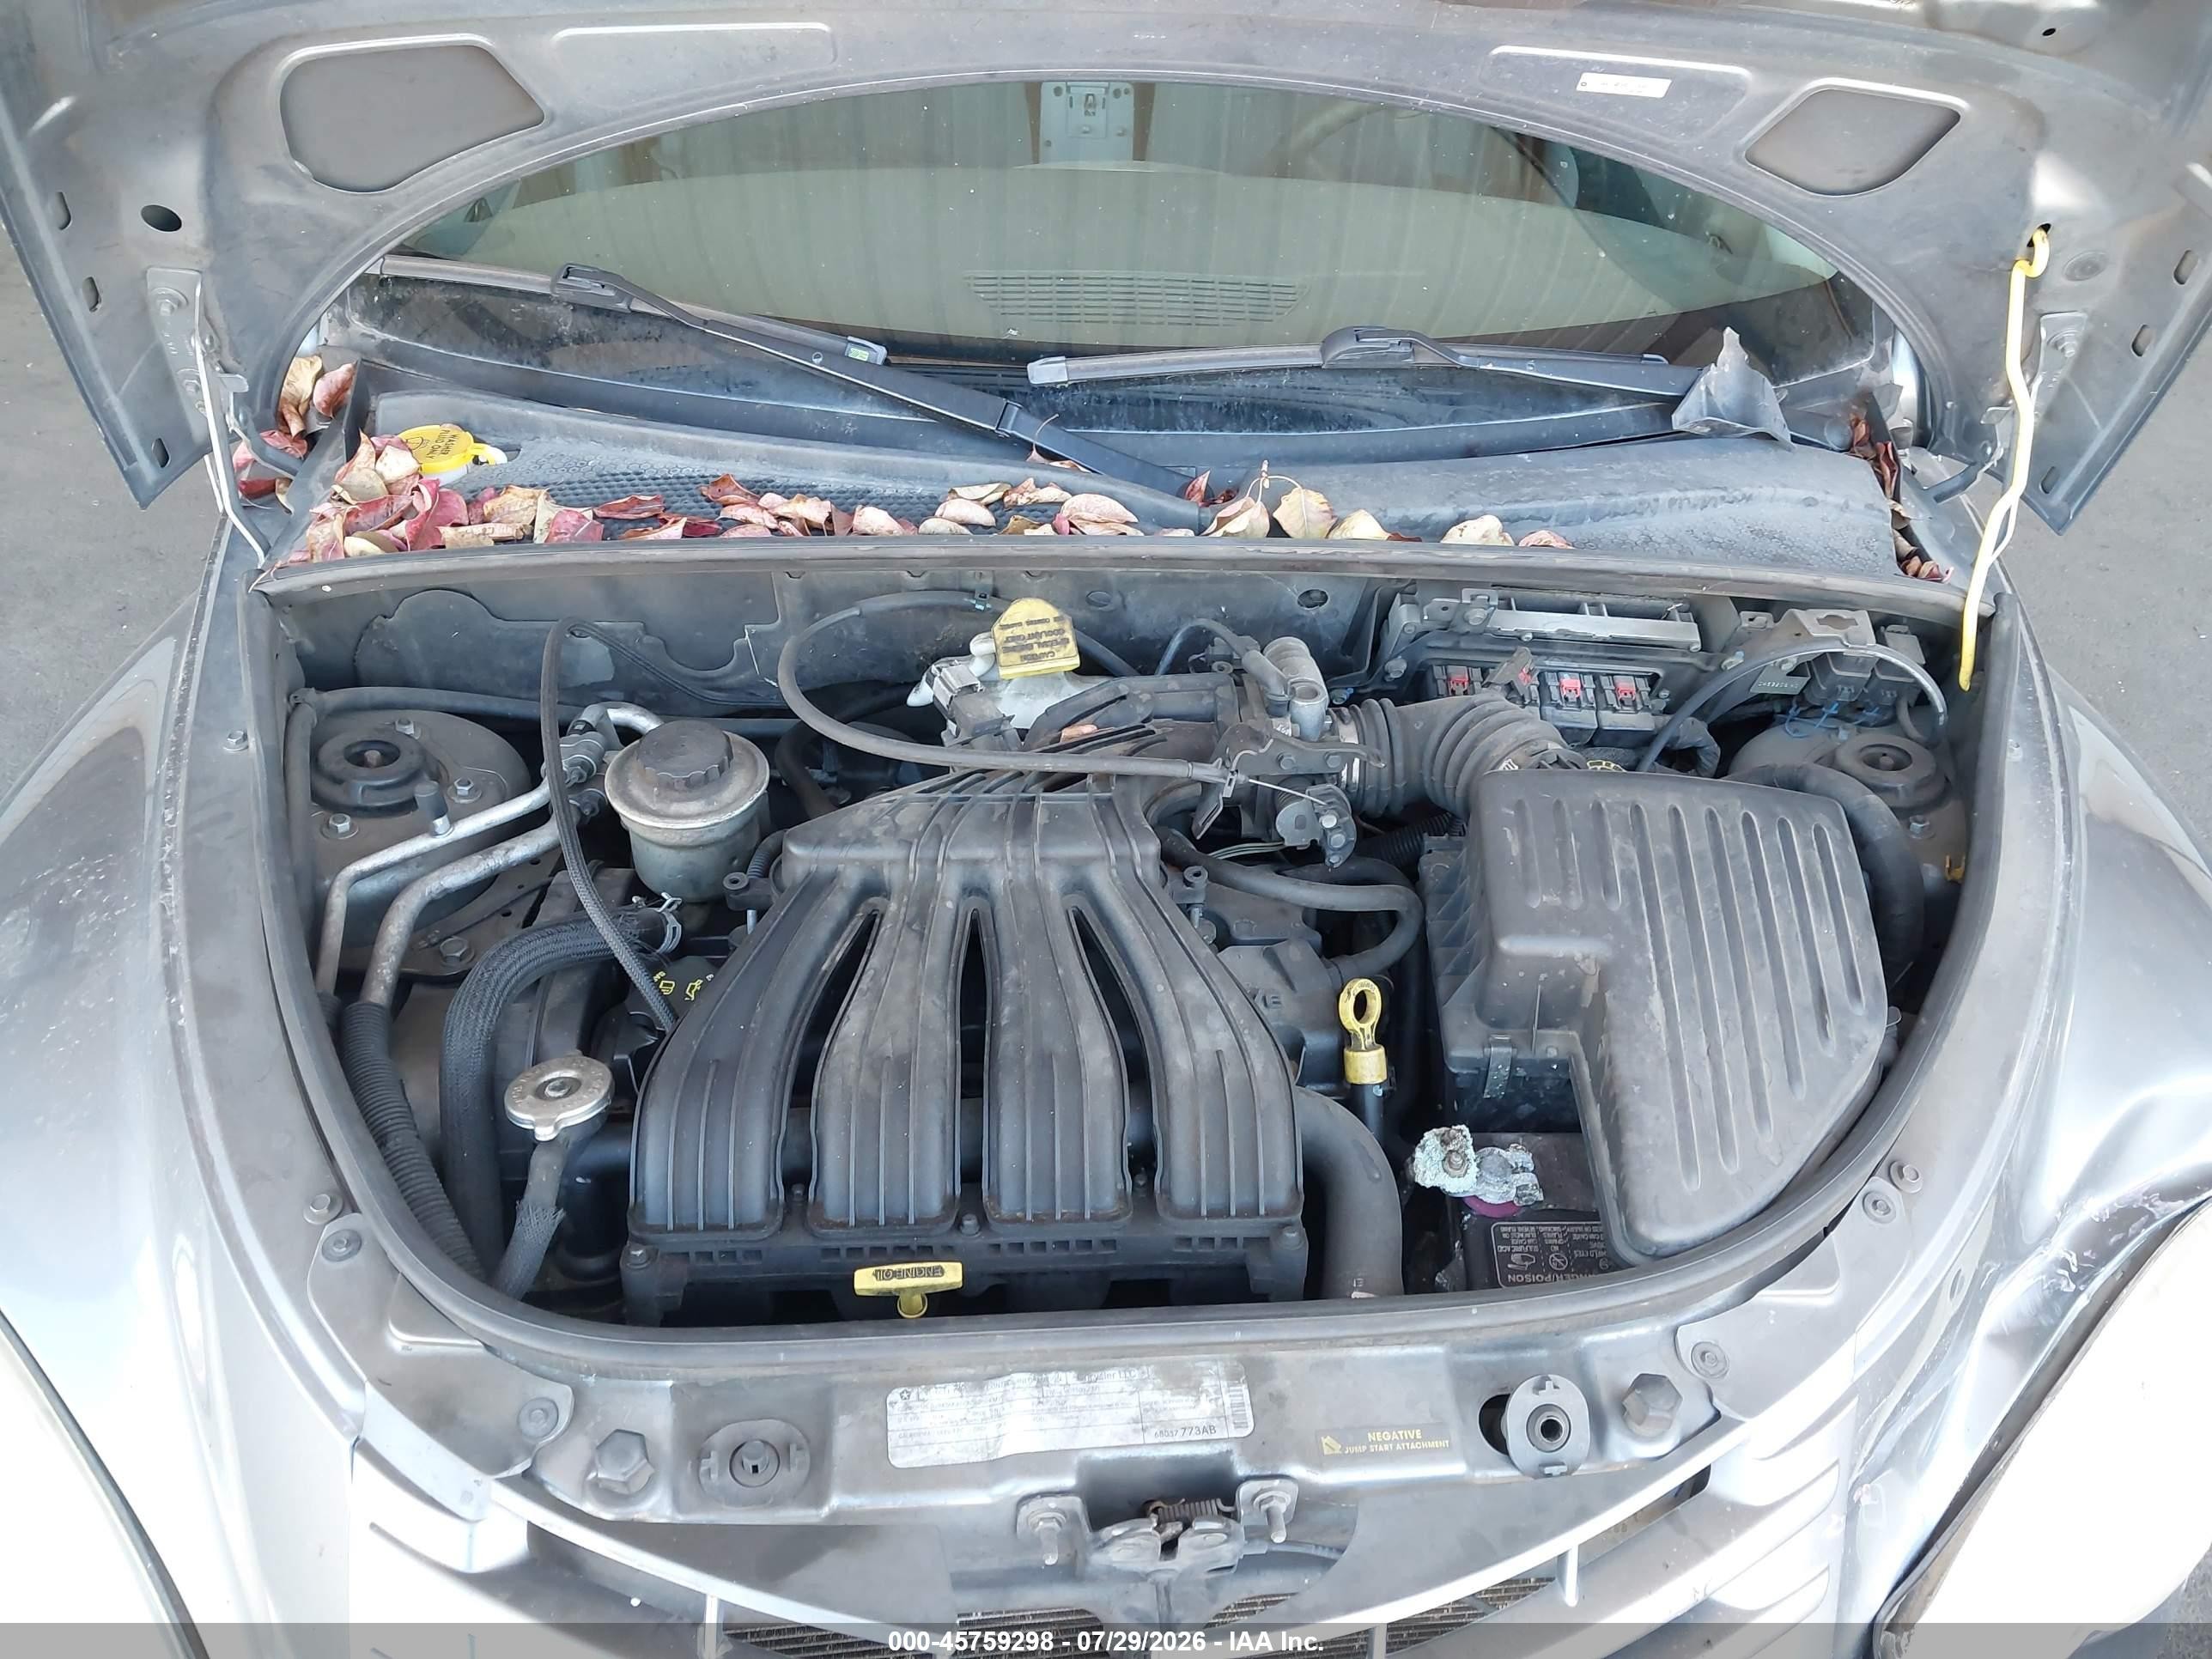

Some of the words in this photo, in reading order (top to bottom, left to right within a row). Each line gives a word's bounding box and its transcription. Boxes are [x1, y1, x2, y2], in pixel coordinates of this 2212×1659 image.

[439, 434, 460, 456] WASHER
[877, 1269, 893, 1280] OIL
[896, 1266, 942, 1279] ENGINE
[1367, 1429, 1422, 1442] NEGATIVE
[1344, 1444, 1367, 1454] JUMP
[1369, 1443, 1393, 1453] START
[1395, 1440, 1449, 1451] ATTACHMENT
